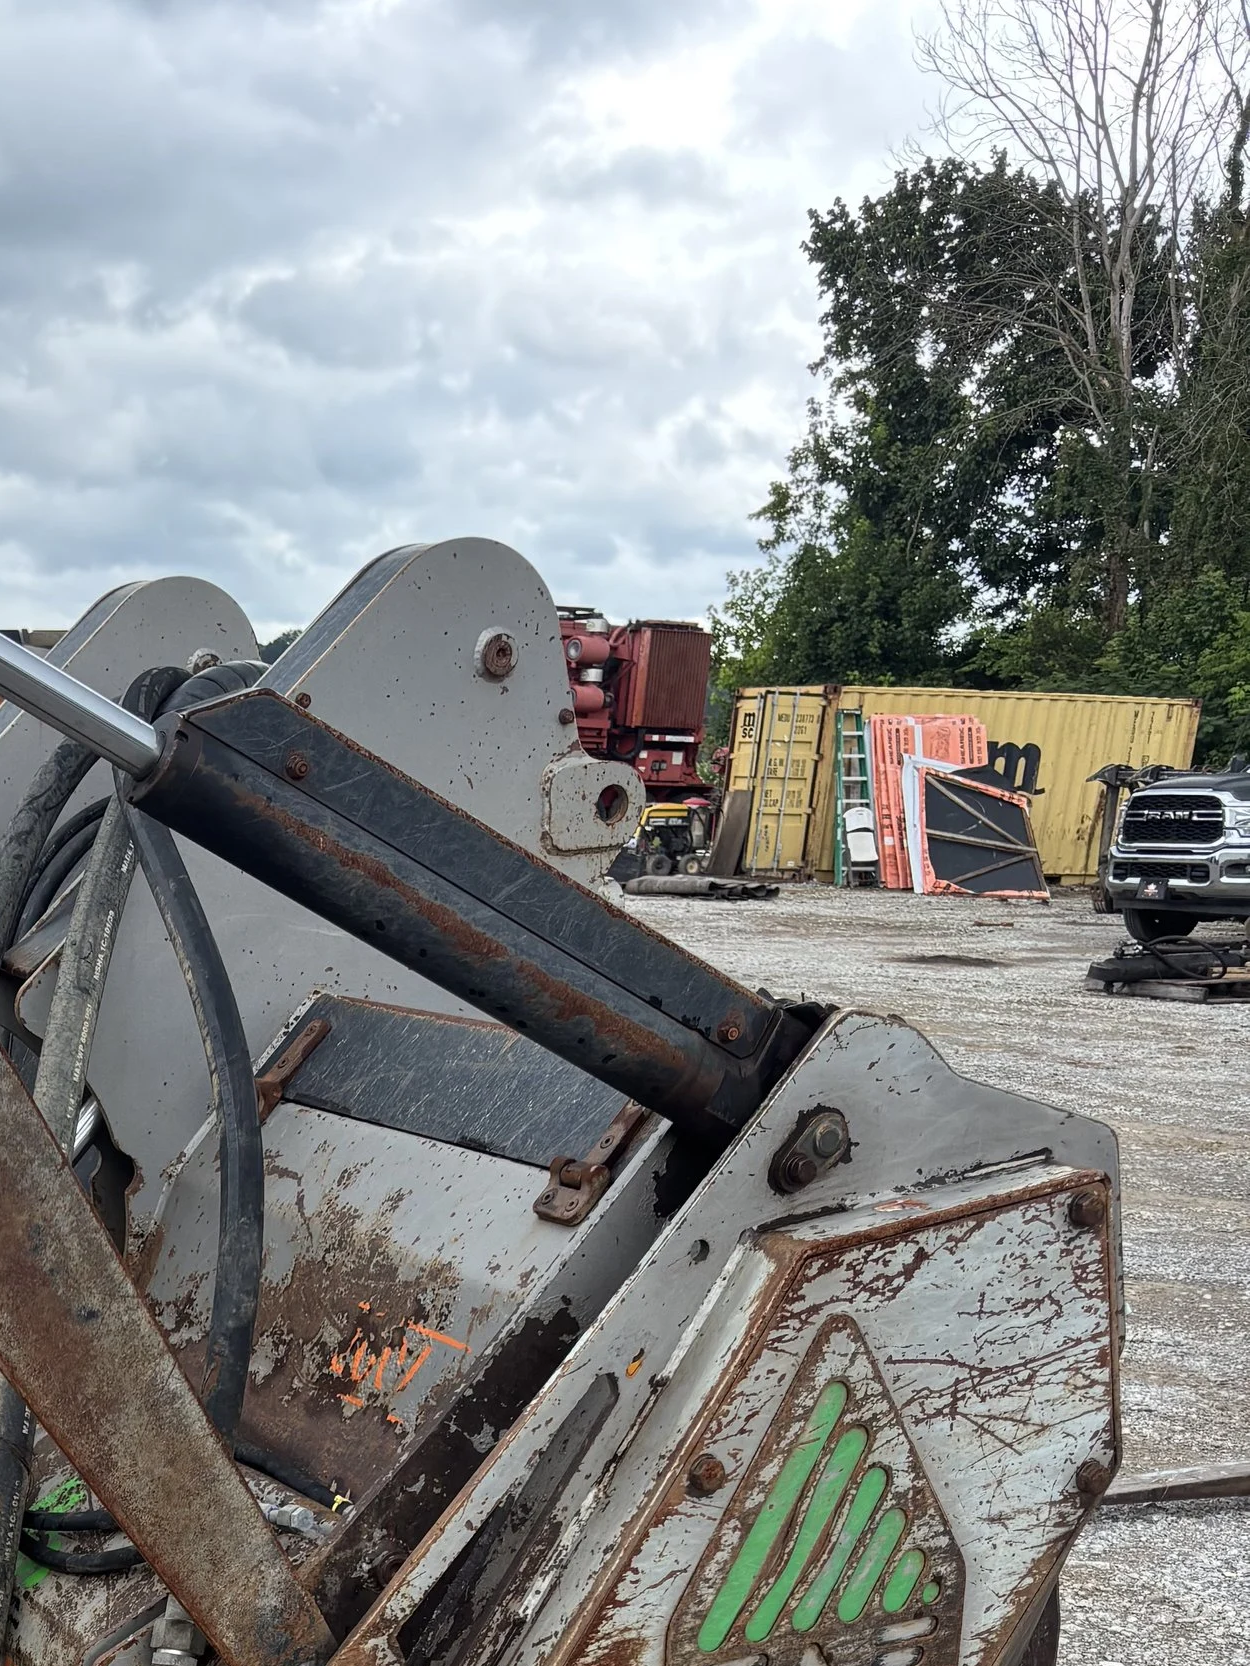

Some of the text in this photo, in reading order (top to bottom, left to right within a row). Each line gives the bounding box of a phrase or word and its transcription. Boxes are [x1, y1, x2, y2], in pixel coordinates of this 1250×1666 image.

[1147, 811, 1190, 821] RAM
[93, 952, 105, 981] MSHA
[84, 1003, 93, 1021] PSI
[80, 1020, 90, 1043] 6000
[77, 1041, 86, 1061] WP
[72, 1061, 83, 1083] MAX
